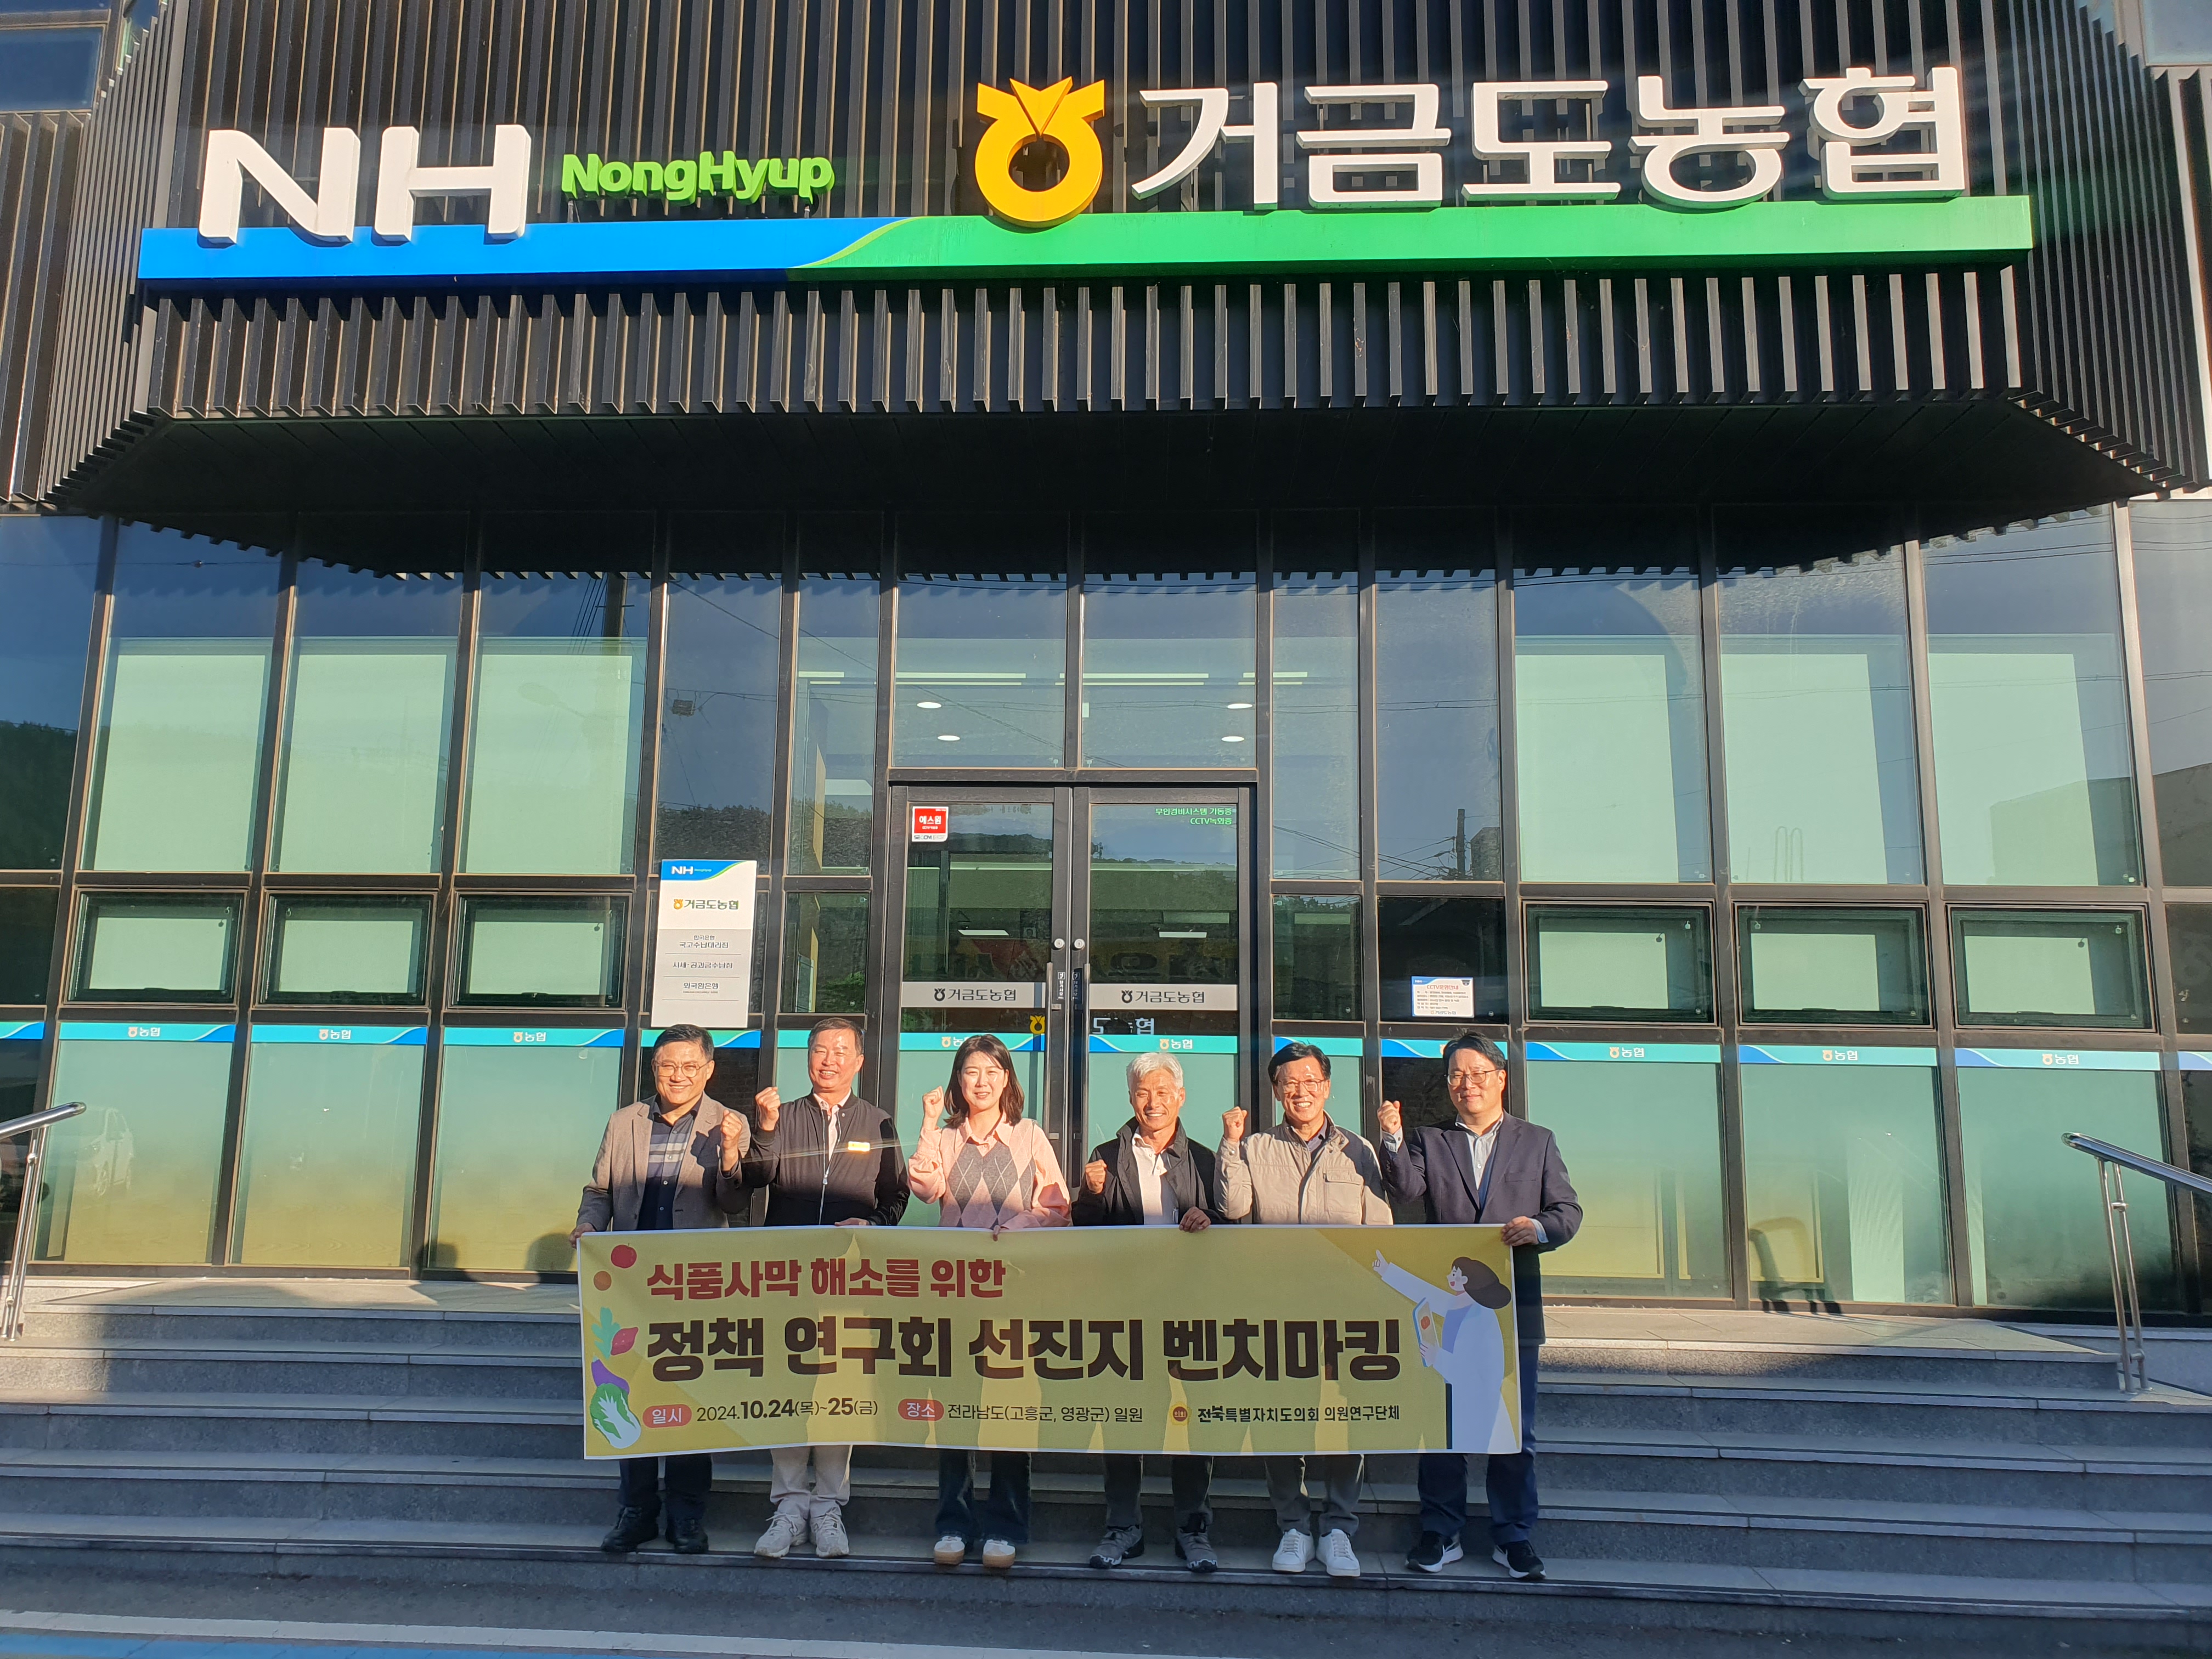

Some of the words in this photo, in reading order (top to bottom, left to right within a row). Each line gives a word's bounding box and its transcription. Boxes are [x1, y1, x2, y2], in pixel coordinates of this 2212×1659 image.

[1131, 66, 1966, 211] 거금도농협
[198, 124, 531, 244] NH
[561, 150, 834, 205] NongHyup
[919, 815, 941, 825] 에스원
[671, 866, 693, 876] NH
[684, 899, 739, 910] 거금도농협
[947, 988, 1017, 1002] 거금도농협
[1135, 991, 1205, 1003] 거금도농협
[139, 1027, 160, 1037] 농협
[330, 1030, 351, 1040] 농협
[525, 1031, 546, 1042] 농협
[1171, 1039, 1193, 1049] 농협
[1621, 1046, 1644, 1058] 농협
[1835, 1049, 1858, 1061] 농협
[2055, 1053, 2079, 1065] 농협
[647, 1260, 802, 1300] 식품사막
[811, 1258, 920, 1297] 해소를
[930, 1259, 1006, 1298] 위한
[647, 1317, 764, 1382] 정책
[785, 1316, 952, 1377] 연구회
[969, 1318, 1144, 1381] 선진지
[1163, 1318, 1401, 1381] 벤치마킹
[651, 1408, 682, 1424] 일시
[696, 1397, 878, 1422] 2024.10.24(목)~25(금)
[906, 1402, 935, 1418] 장소
[947, 1404, 1057, 1423] 전라남도(고흥군,
[1060, 1406, 1110, 1423] 영광군)
[1114, 1407, 1143, 1423] 일원
[1174, 1410, 1187, 1419] 의회
[1197, 1405, 1319, 1423] 전북특별자치도의회
[1324, 1405, 1400, 1422] 의원연구단체
